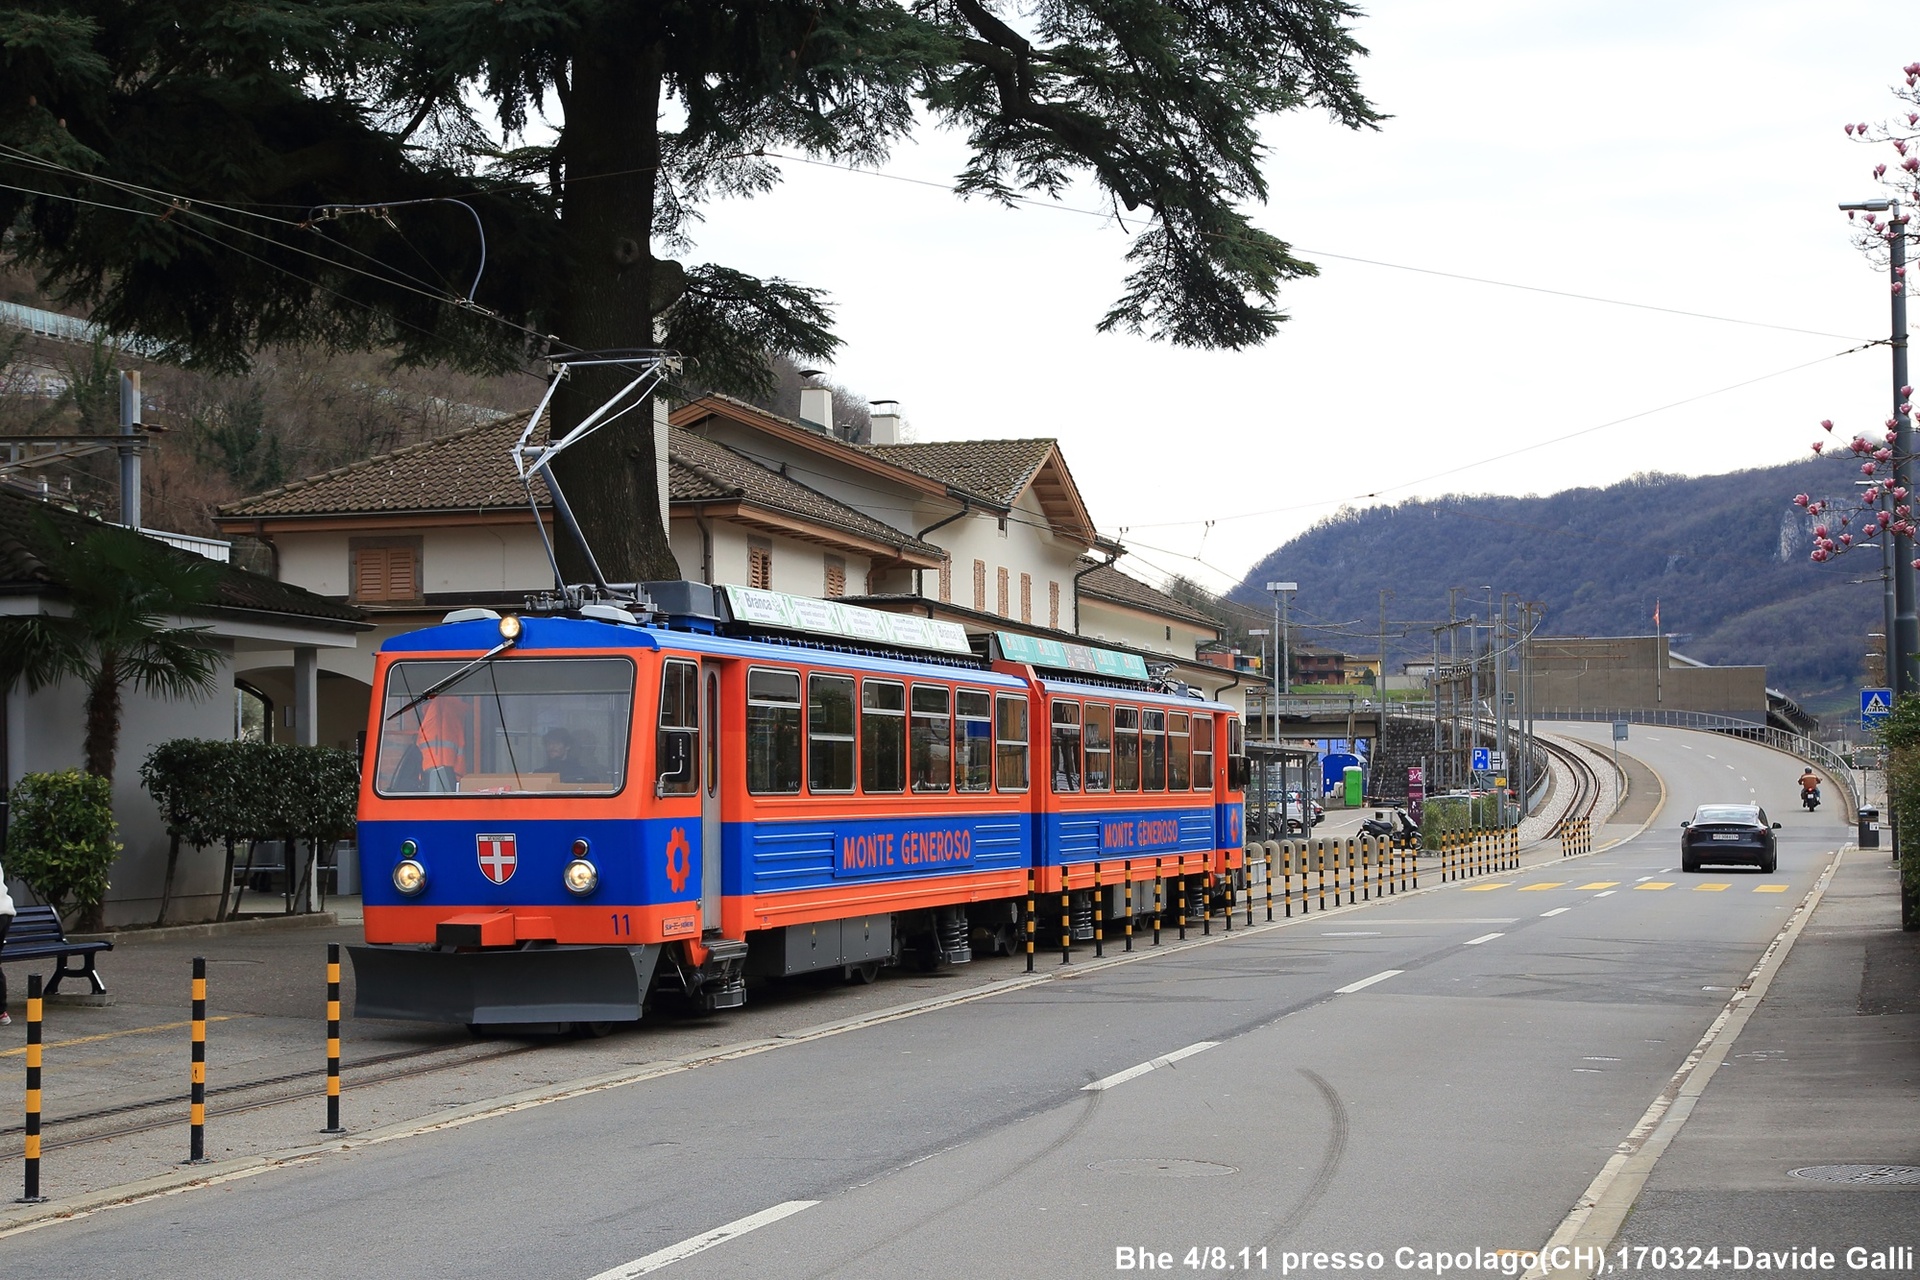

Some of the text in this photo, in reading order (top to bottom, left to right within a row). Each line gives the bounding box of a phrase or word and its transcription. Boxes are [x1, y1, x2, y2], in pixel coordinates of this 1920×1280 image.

[744, 592, 772, 611] Branca
[1104, 820, 1178, 848] MONTE GENEROSO
[843, 829, 971, 869] MONTE GENEROSO
[611, 914, 630, 935] 11
